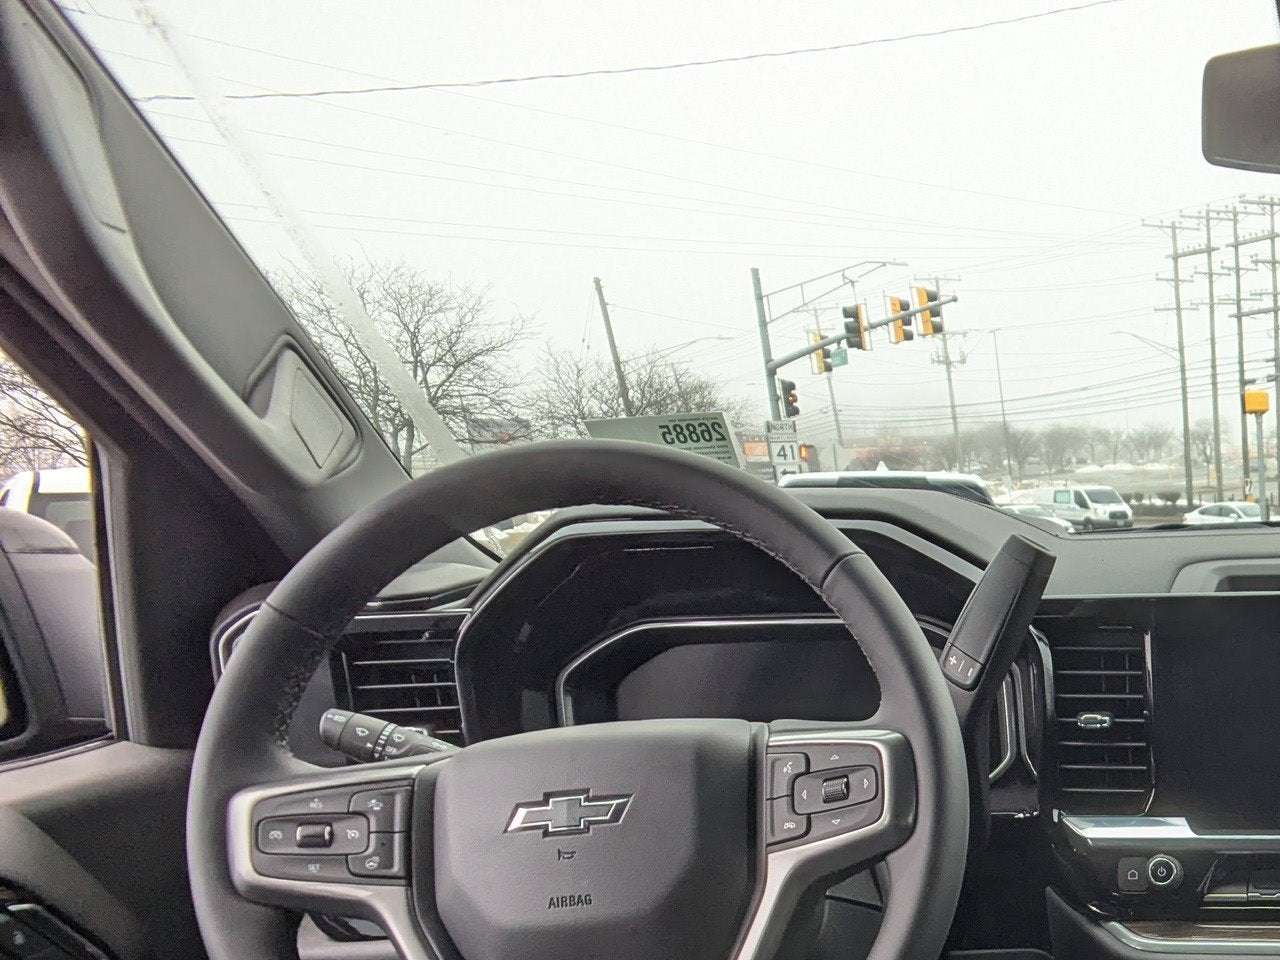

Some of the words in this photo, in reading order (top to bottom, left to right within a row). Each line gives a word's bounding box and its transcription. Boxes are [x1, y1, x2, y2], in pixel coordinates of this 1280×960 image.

[770, 422, 793, 430] NORTH
[776, 444, 795, 460] 41
[386, 746, 399, 754] OFF
[308, 864, 320, 873] SET
[548, 894, 592, 909] AIRBAG
